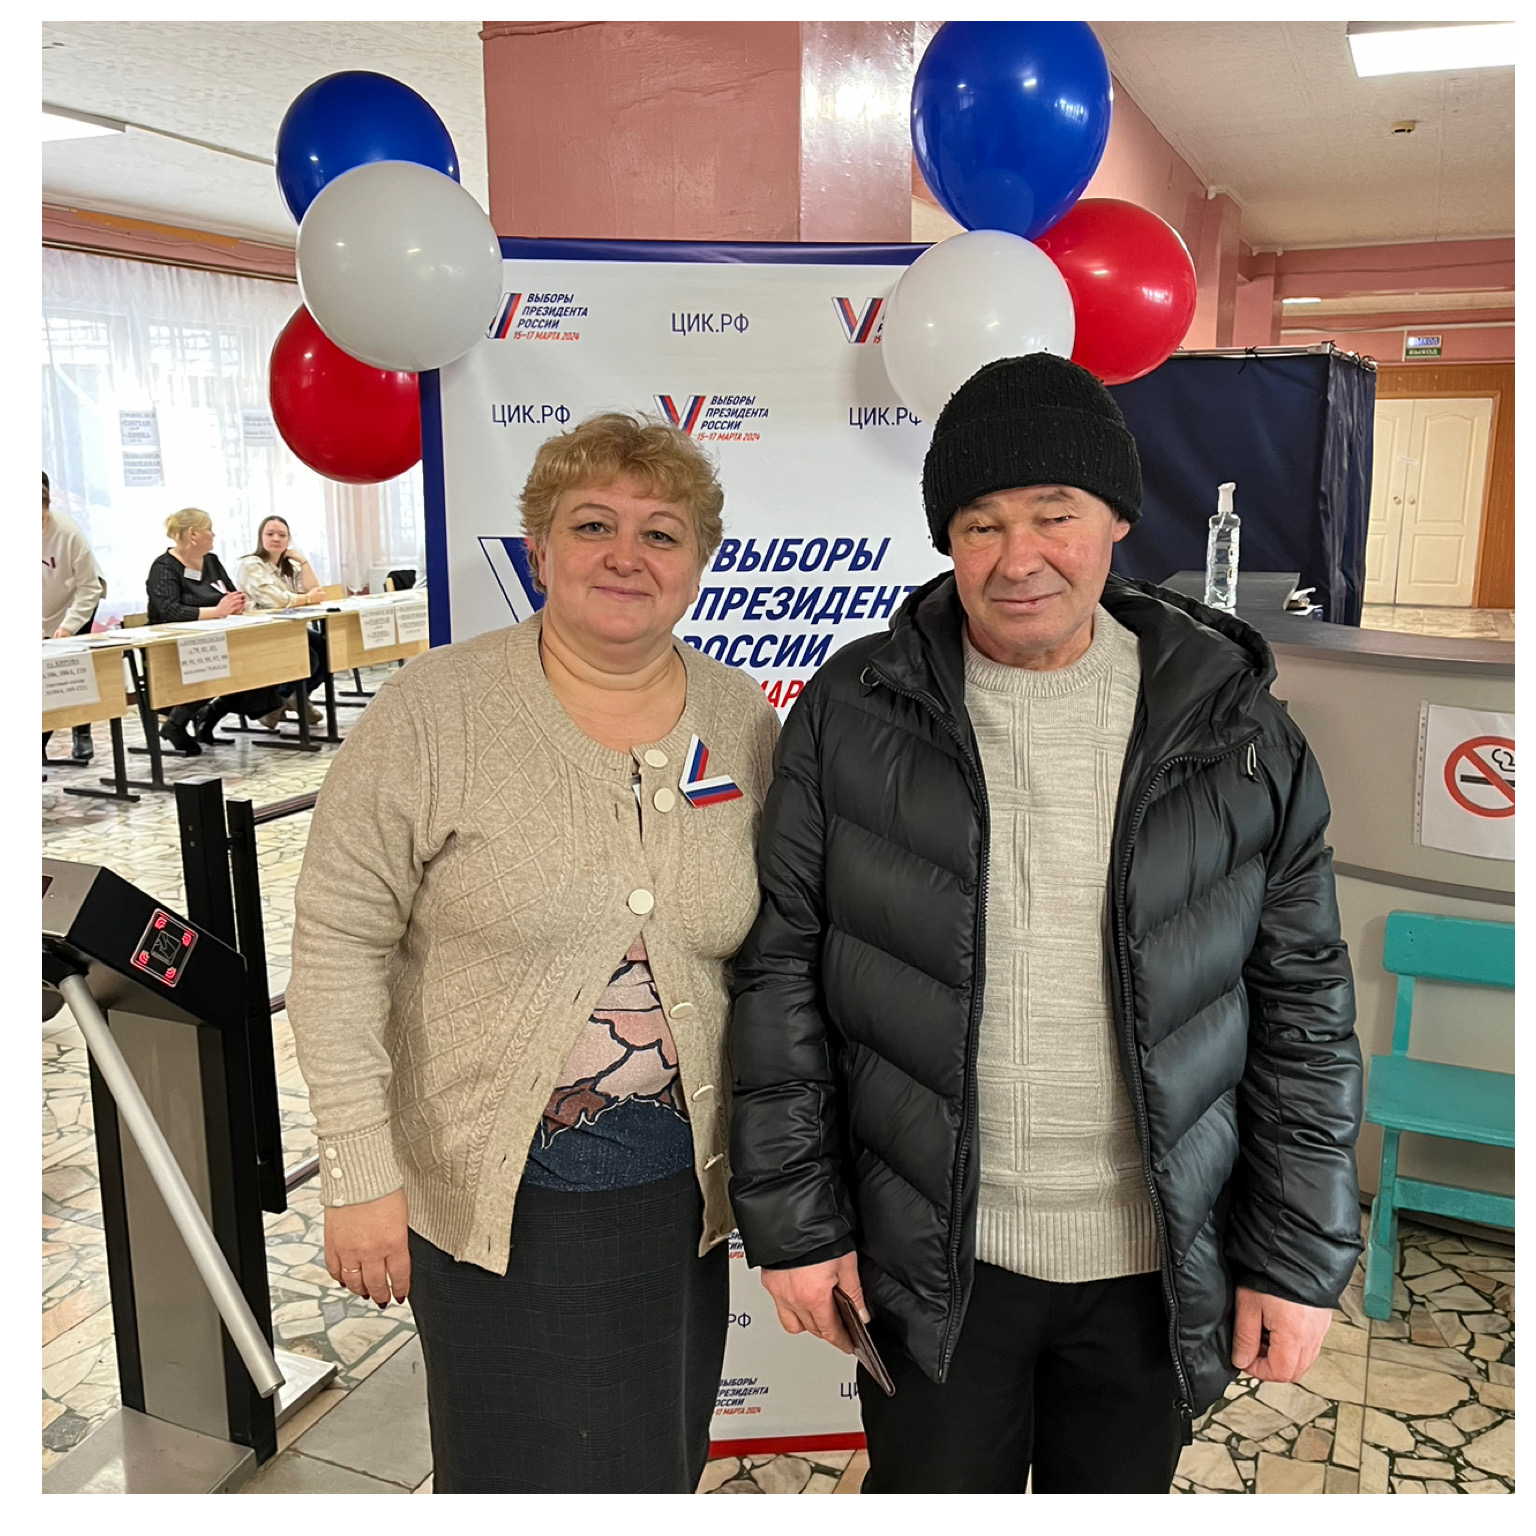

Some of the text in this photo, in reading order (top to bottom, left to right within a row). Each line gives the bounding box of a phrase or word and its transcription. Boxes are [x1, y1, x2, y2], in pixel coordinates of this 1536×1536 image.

[527, 293, 575, 303] ВЫБОРЫ
[522, 306, 589, 317] ПРЕЗИДЕНТА
[517, 319, 560, 328] РОССИИ
[671, 313, 749, 336] ЦИК.РФ
[535, 331, 561, 340] МАРТА
[561, 332, 580, 340] 2024
[710, 395, 756, 405] ВЫБОРЫ
[492, 404, 571, 427] ЦИК.РФ
[705, 408, 769, 418] ПРЕЗИДЕНТА
[700, 420, 742, 430] РОССИИ
[717, 433, 741, 441] МАРТА
[743, 432, 760, 441] 2024
[711, 538, 892, 573] ВЫБОРЫ
